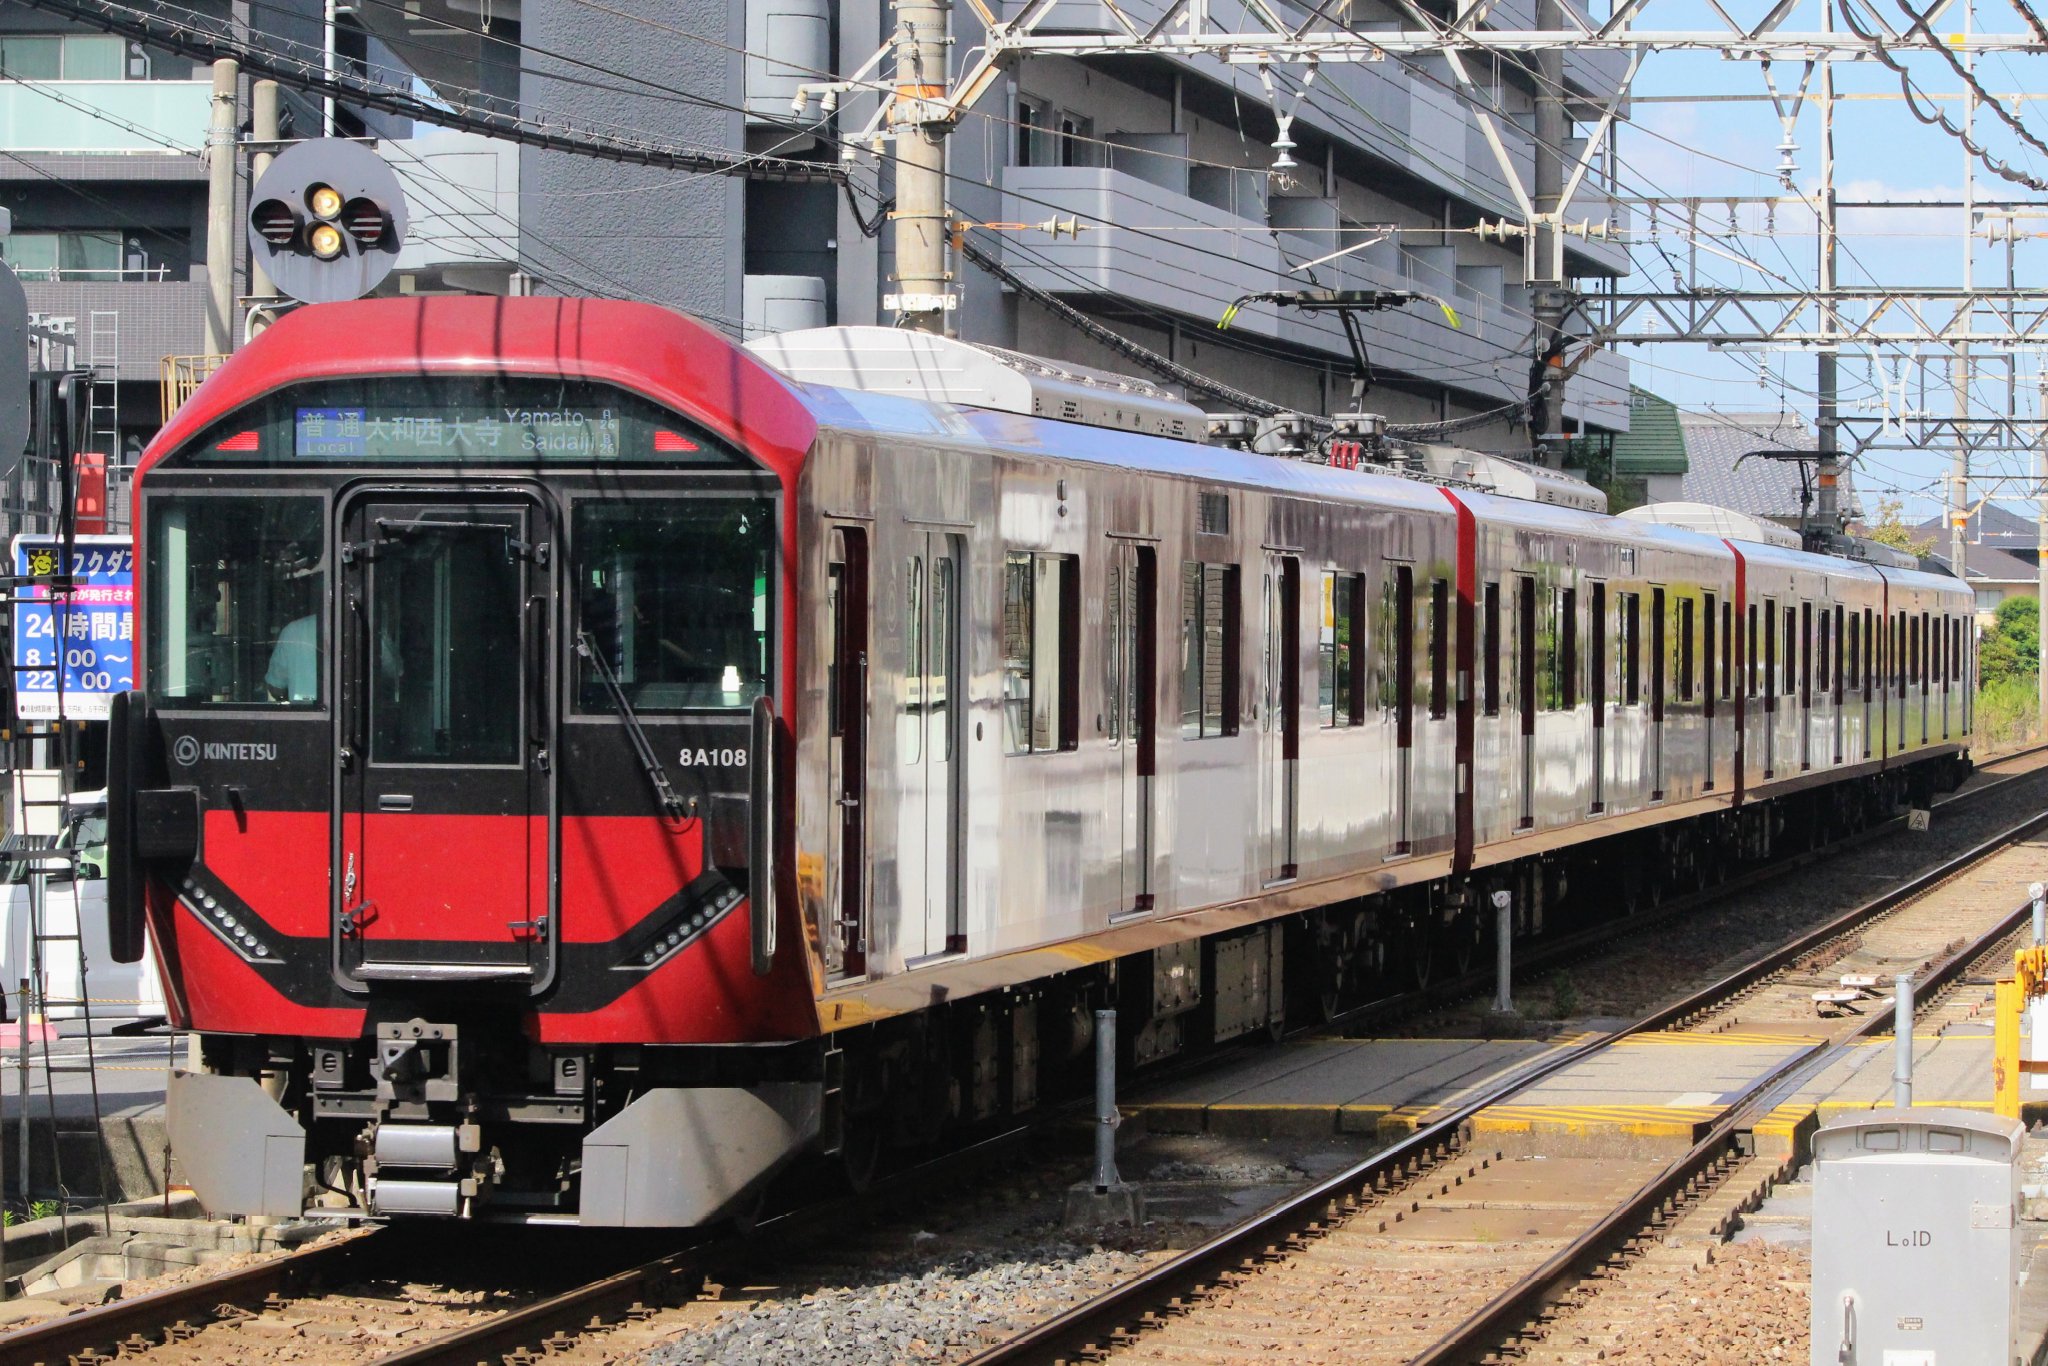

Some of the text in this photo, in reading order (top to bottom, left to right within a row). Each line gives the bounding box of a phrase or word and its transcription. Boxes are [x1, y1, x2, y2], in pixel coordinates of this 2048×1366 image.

[504, 408, 593, 427] Yamato-
[302, 412, 502, 448] 普通 大和西大寺
[307, 441, 354, 454] Local
[521, 432, 595, 456] Saidaiji
[204, 743, 277, 760] KINTETSU
[679, 748, 747, 767] 8A108
